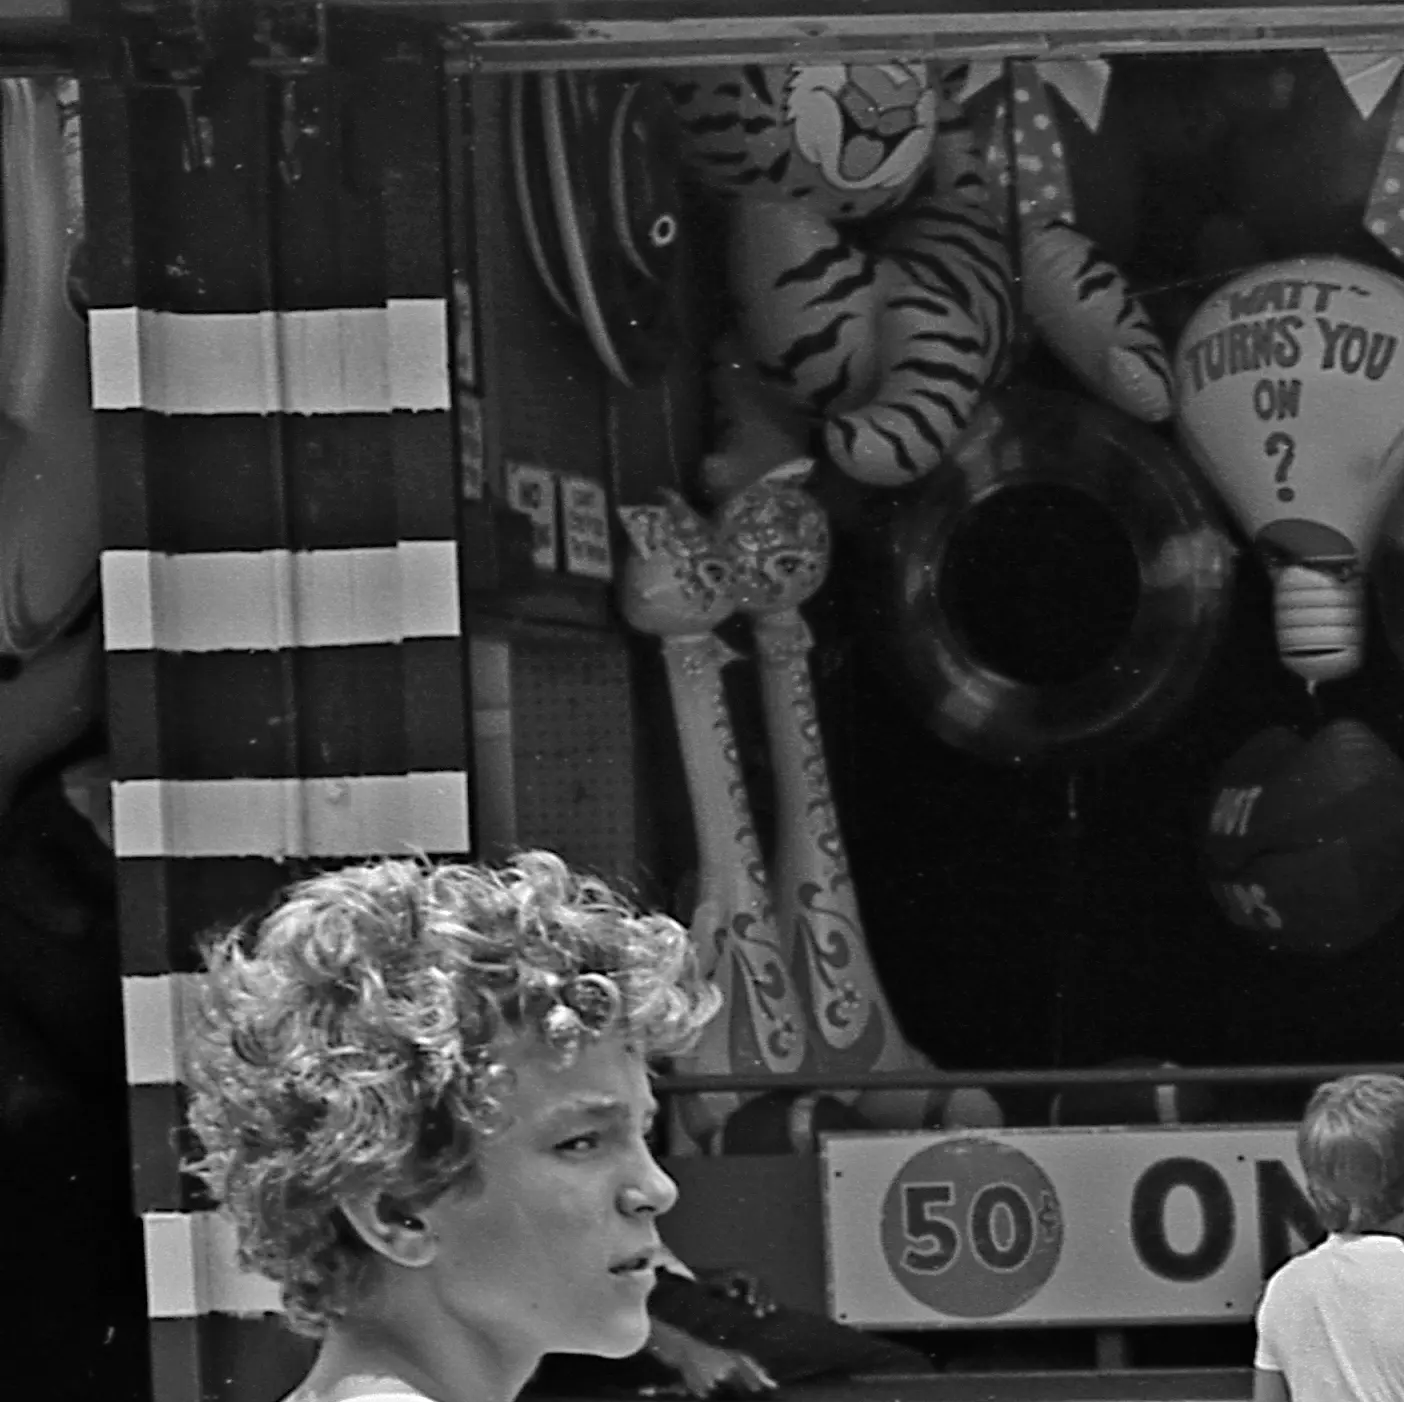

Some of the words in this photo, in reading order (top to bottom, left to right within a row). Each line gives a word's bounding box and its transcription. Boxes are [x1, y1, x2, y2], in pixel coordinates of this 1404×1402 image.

[1186, 314, 1305, 392] TURNS
[1315, 317, 1399, 381] YOU
[1253, 378, 1303, 420] ON
[1264, 431, 1295, 503] ?
